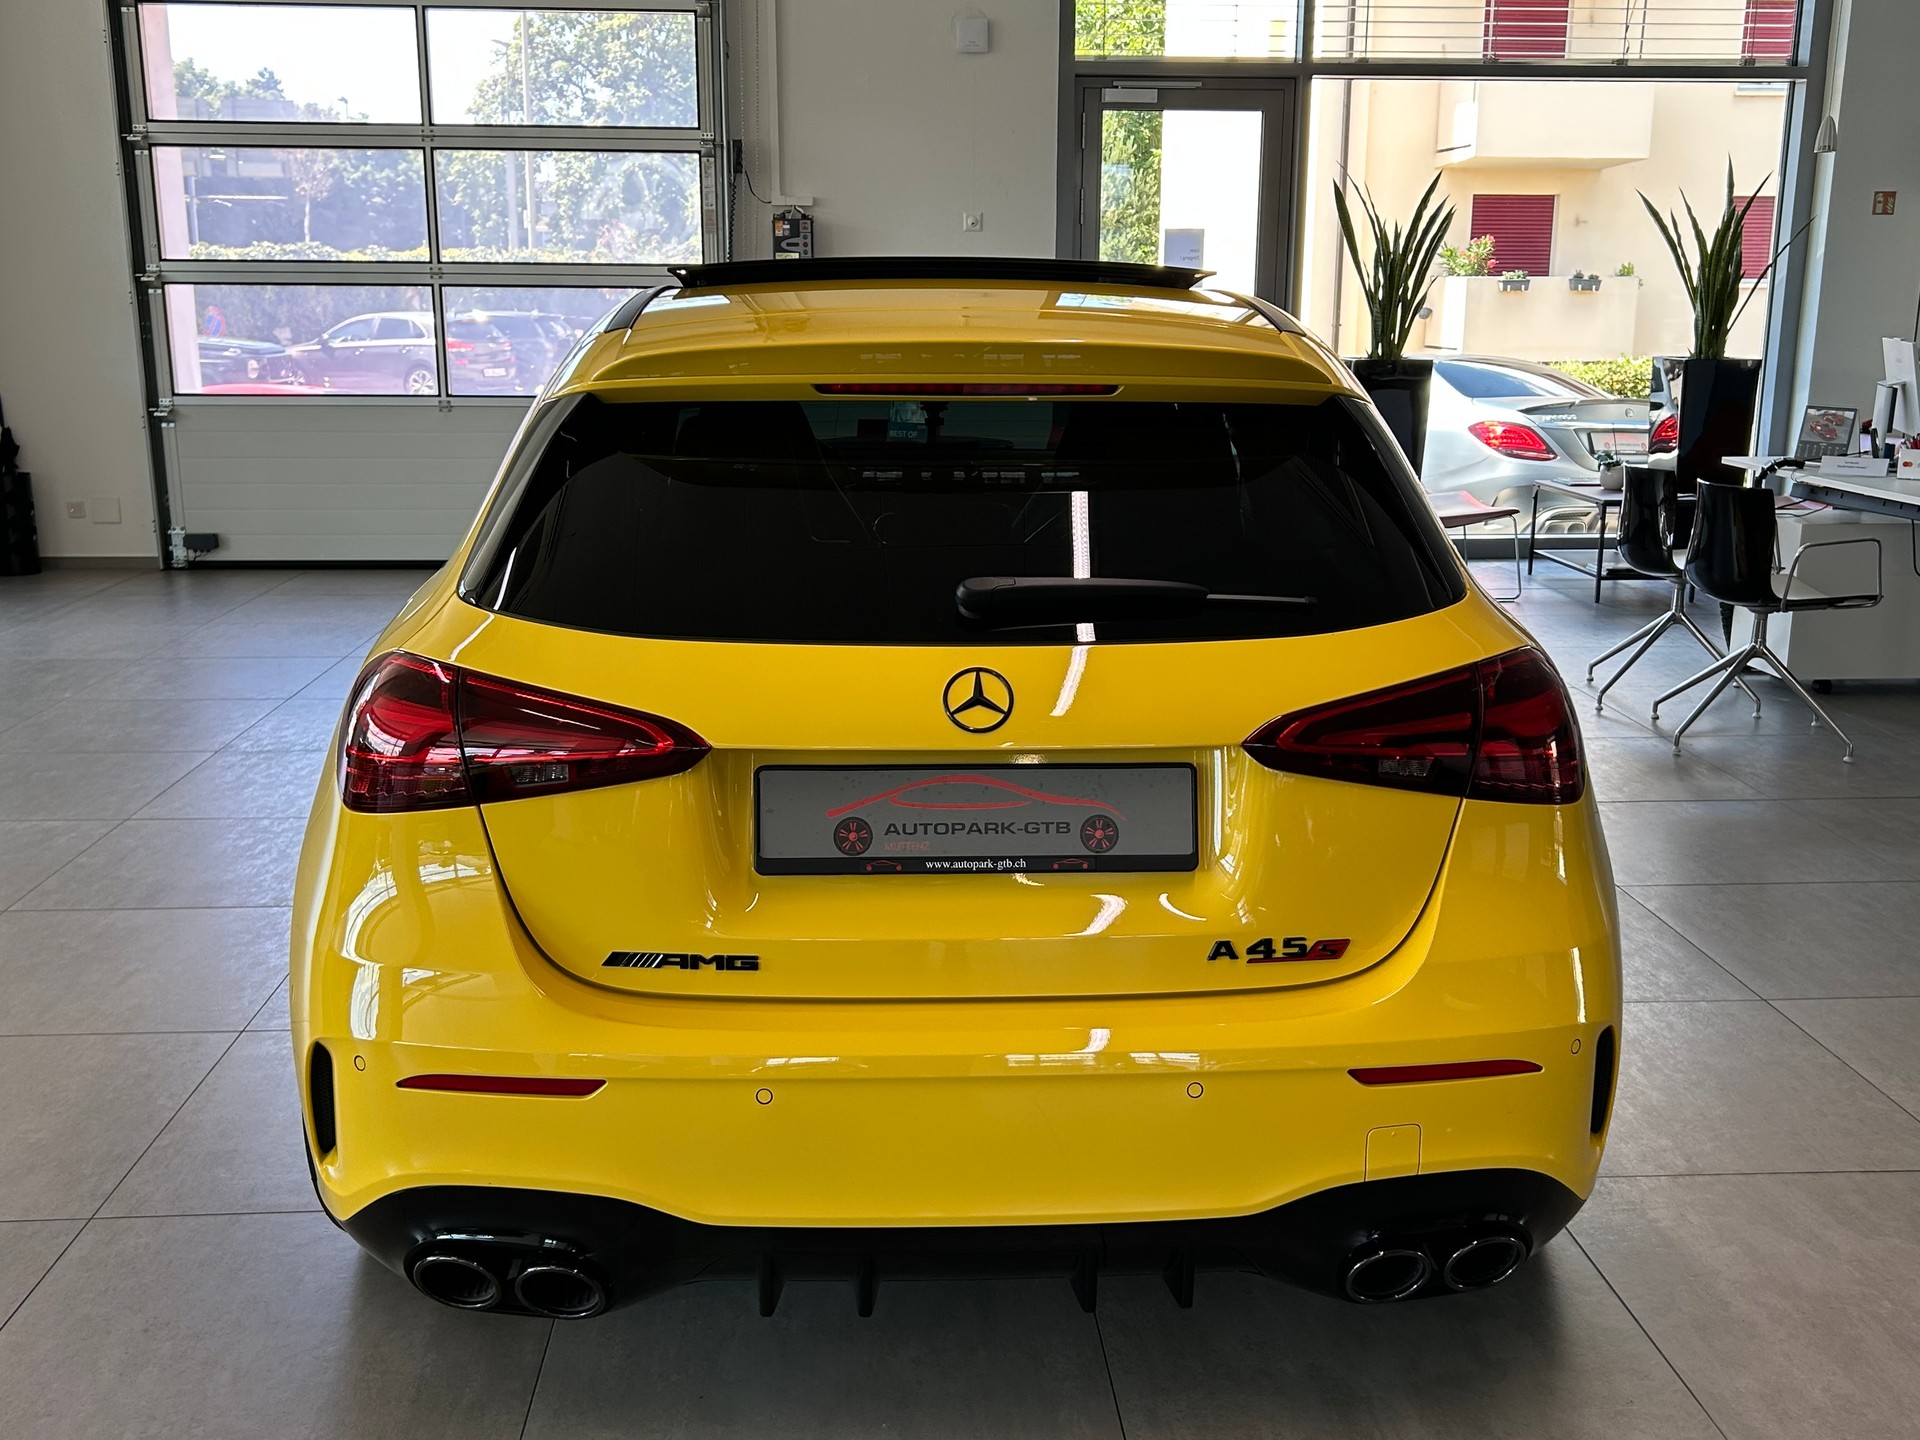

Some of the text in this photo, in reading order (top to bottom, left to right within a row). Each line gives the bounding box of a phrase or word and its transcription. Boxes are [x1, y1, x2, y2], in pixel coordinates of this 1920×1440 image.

[889, 429, 918, 439] BEST OF
[883, 820, 1071, 837] AUTOPARK-GTB
[925, 858, 1027, 871] www.autopark-gtb.ch
[650, 952, 760, 971] AMG
